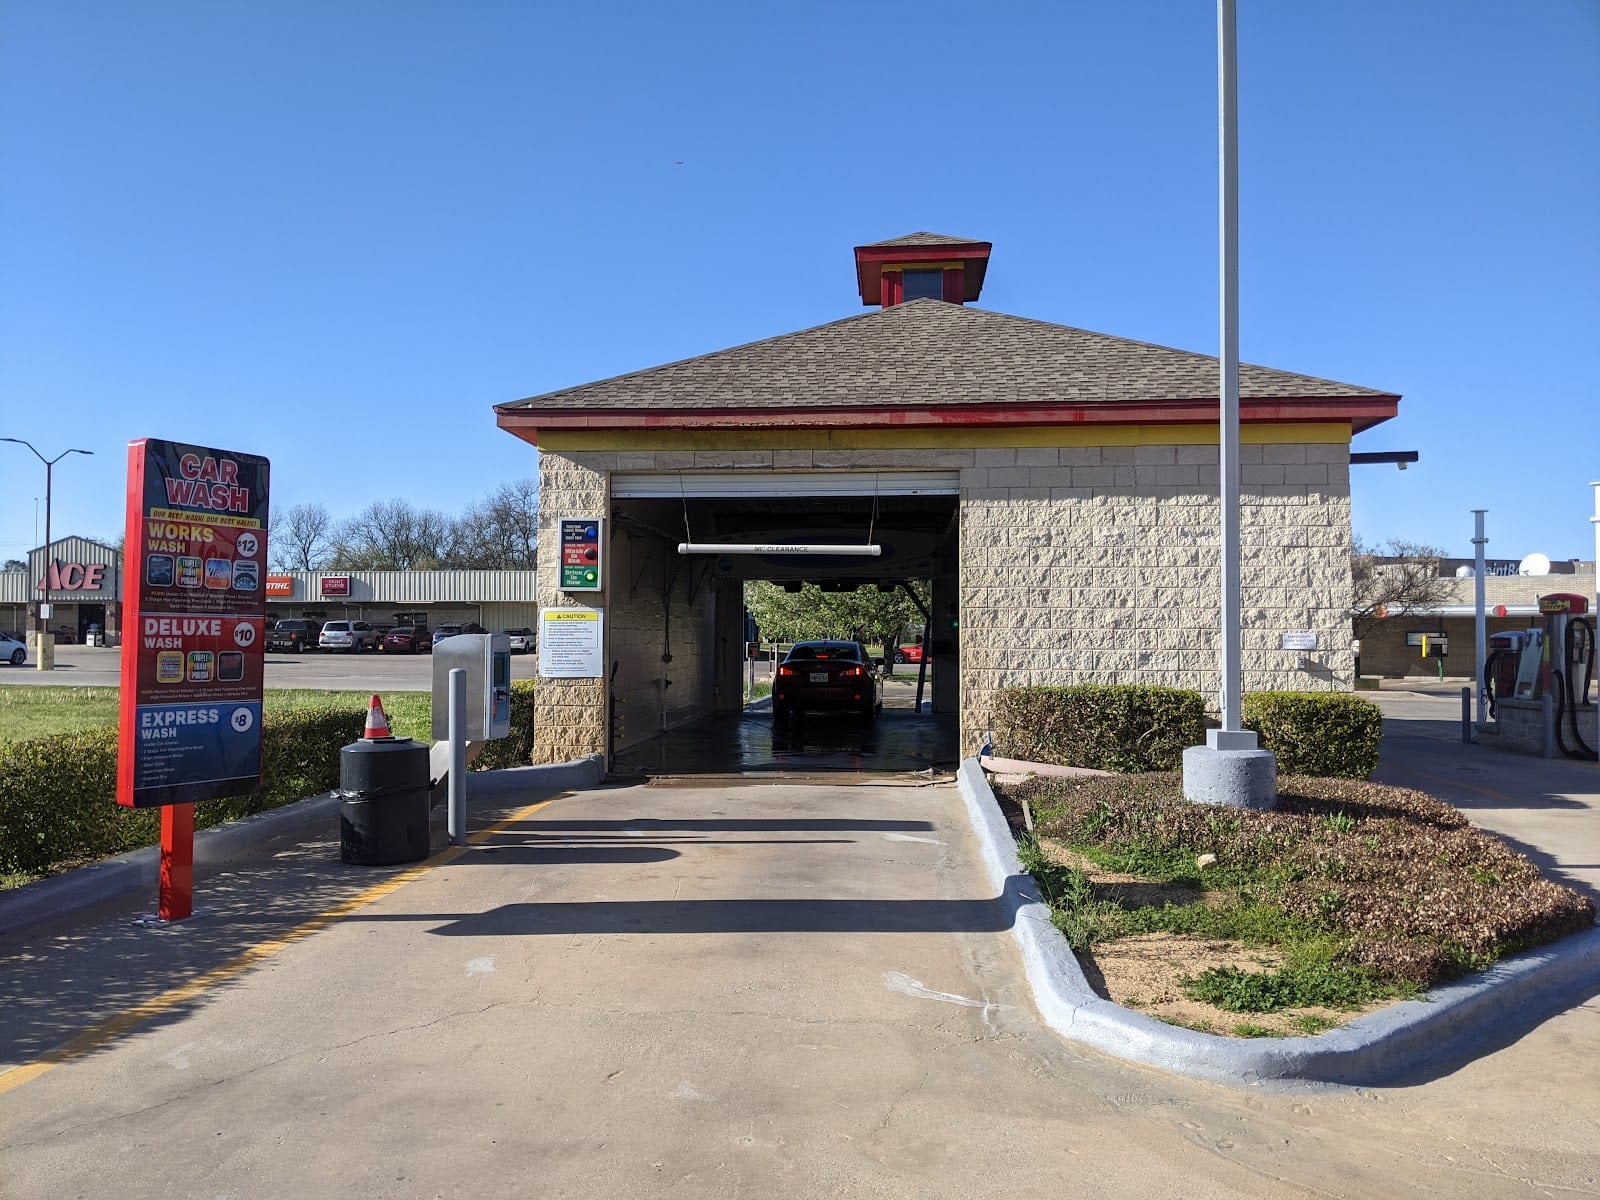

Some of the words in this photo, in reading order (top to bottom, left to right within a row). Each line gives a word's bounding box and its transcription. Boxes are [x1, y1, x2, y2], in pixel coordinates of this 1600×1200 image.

[180, 453, 239, 486] CAR
[165, 477, 249, 513] WASH
[153, 510, 166, 518] OUR
[168, 511, 182, 519] BEST
[185, 513, 205, 521] WASH!
[206, 515, 219, 523] OUR
[220, 517, 235, 525] BEST
[148, 522, 214, 543] WORKS
[148, 539, 186, 554] WASH
[237, 539, 255, 553] $12
[37, 560, 104, 590] ACE
[266, 582, 290, 590] STIHL
[145, 619, 222, 636] DELUXE
[144, 637, 183, 649] WASH
[235, 629, 253, 642] $10
[142, 709, 219, 728] EXPRESS
[234, 714, 247, 727] $8
[141, 729, 177, 740] WASH
